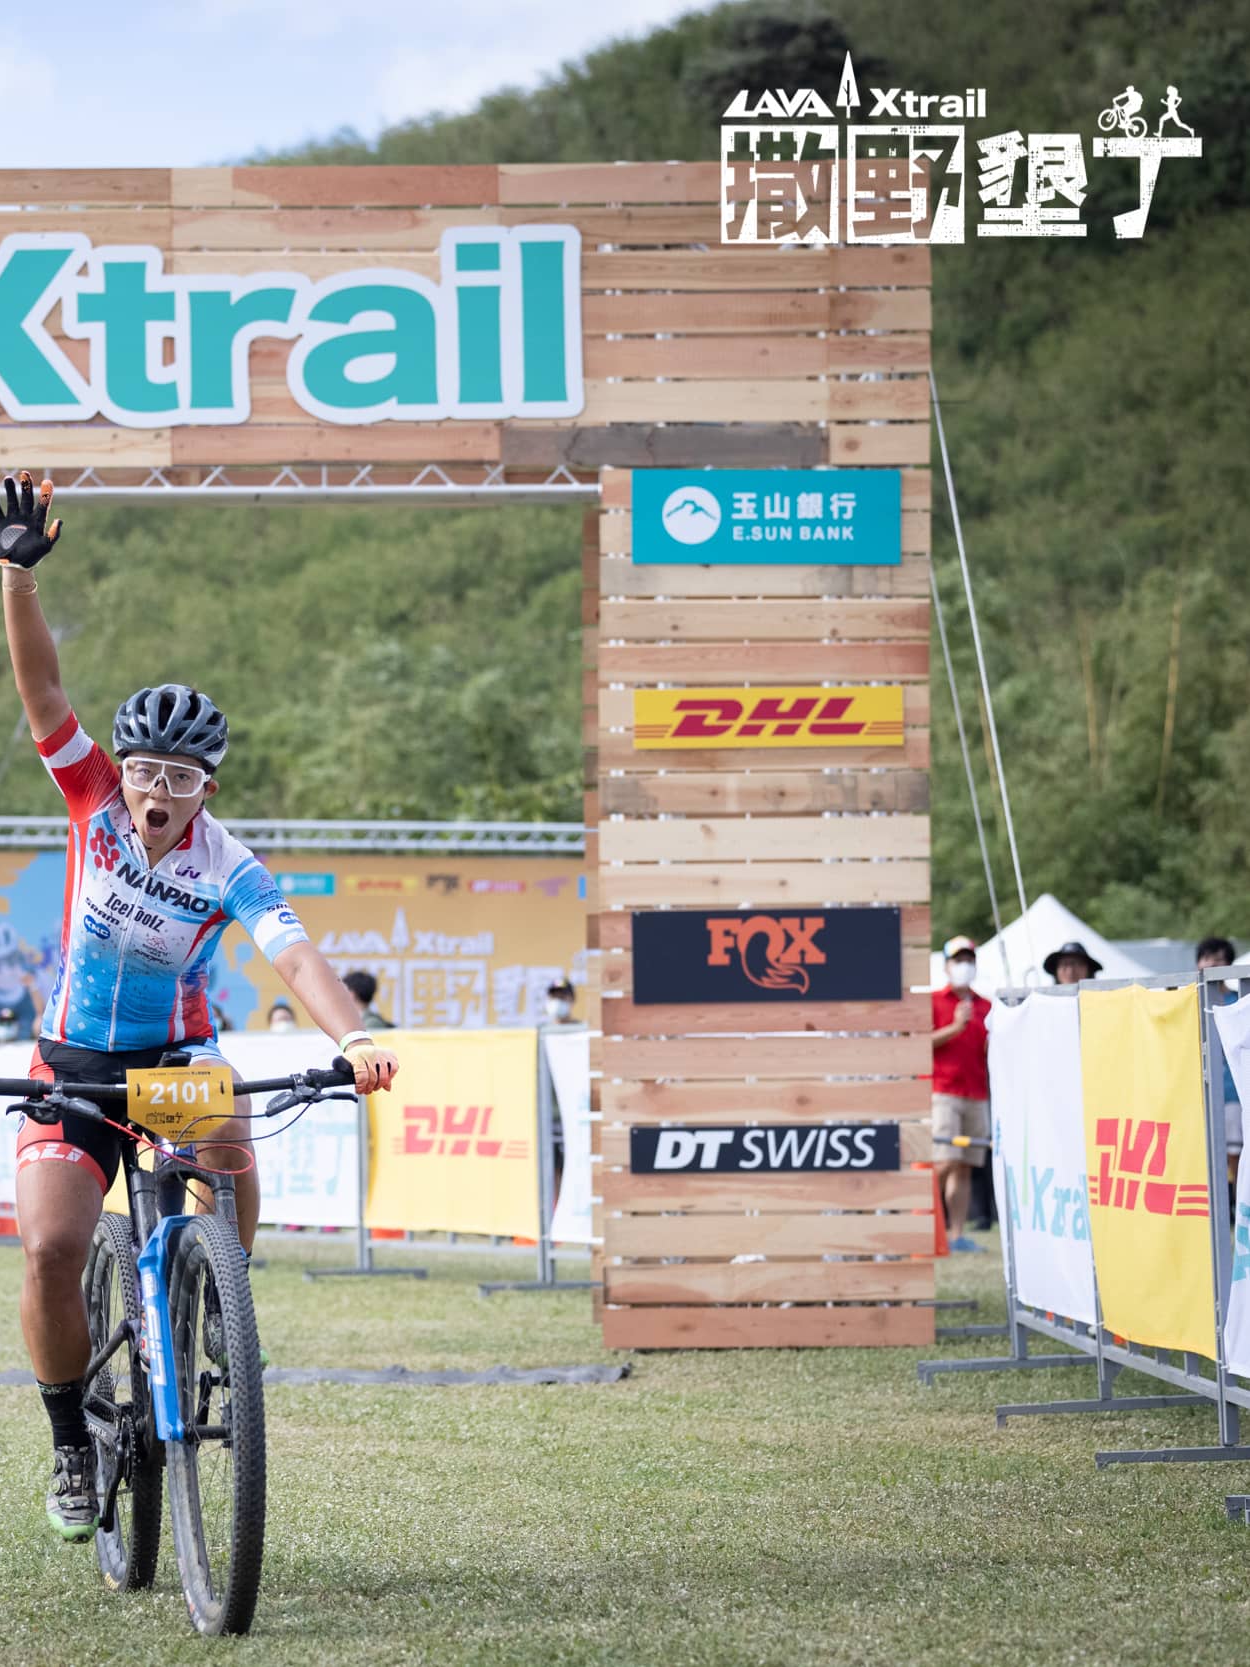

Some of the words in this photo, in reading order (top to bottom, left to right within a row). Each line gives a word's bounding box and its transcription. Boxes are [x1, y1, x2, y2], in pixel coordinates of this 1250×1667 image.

[732, 492, 856, 520] 玉山銀行
[733, 526, 792, 541] E.SUN
[800, 526, 854, 541] BANK
[671, 697, 867, 737] DHL
[116, 862, 210, 913] NANPAO
[413, 931, 494, 954] Xtrail
[706, 915, 826, 990] FOX
[150, 1081, 210, 1104] 2101
[402, 1105, 502, 1157] DHL
[654, 1130, 734, 1169] DT
[739, 1128, 876, 1168] SWISS
[1095, 1118, 1178, 1217] DHL
